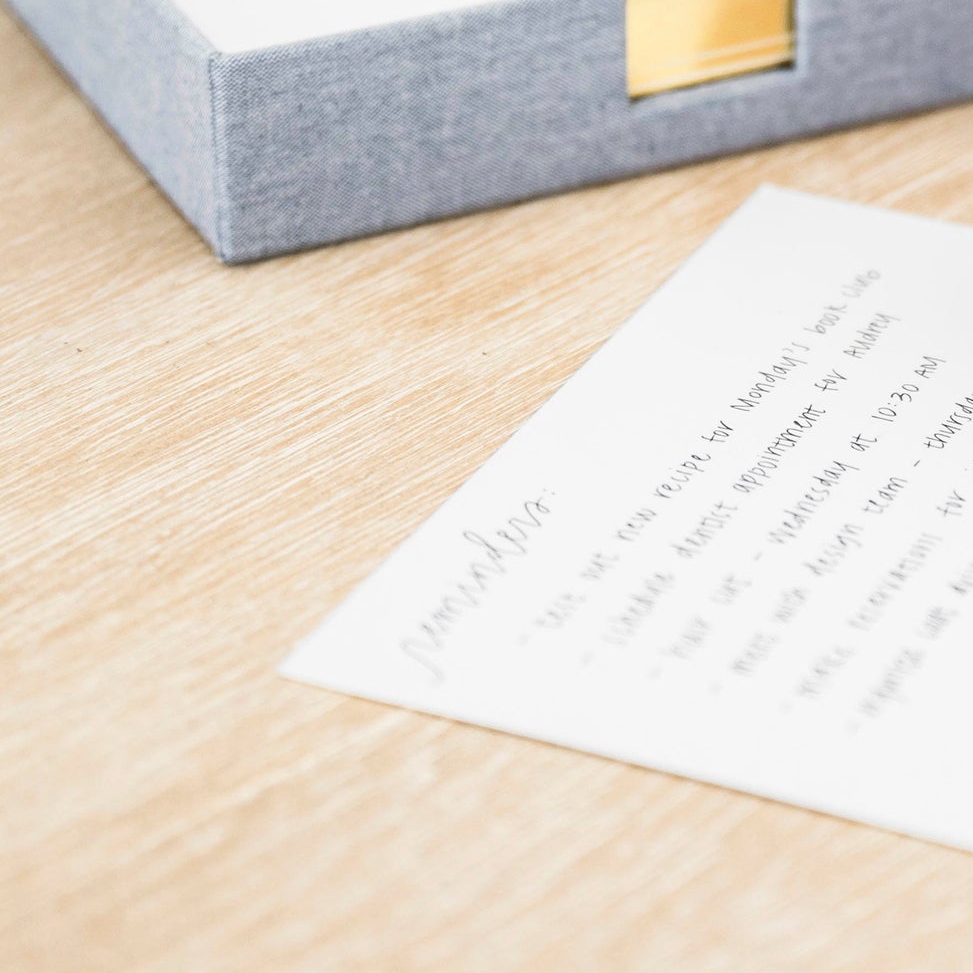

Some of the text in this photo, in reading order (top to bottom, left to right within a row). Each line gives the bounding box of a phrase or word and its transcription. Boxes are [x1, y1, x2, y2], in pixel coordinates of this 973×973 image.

[613, 507, 658, 542] new
[652, 452, 712, 500] recipe
[699, 419, 734, 443] for
[728, 340, 811, 412] Monday's
[801, 303, 848, 335] book
[669, 500, 739, 559] dentist
[730, 402, 827, 494] appointment
[812, 367, 848, 392] for
[841, 311, 901, 360] Audrey
[848, 432, 879, 452] at
[869, 382, 920, 423] 10:30
[912, 354, 947, 380] AM
[801, 522, 864, 577] design
[860, 475, 908, 515] team
[934, 488, 967, 518] for
[399, 487, 557, 685] reminders:
